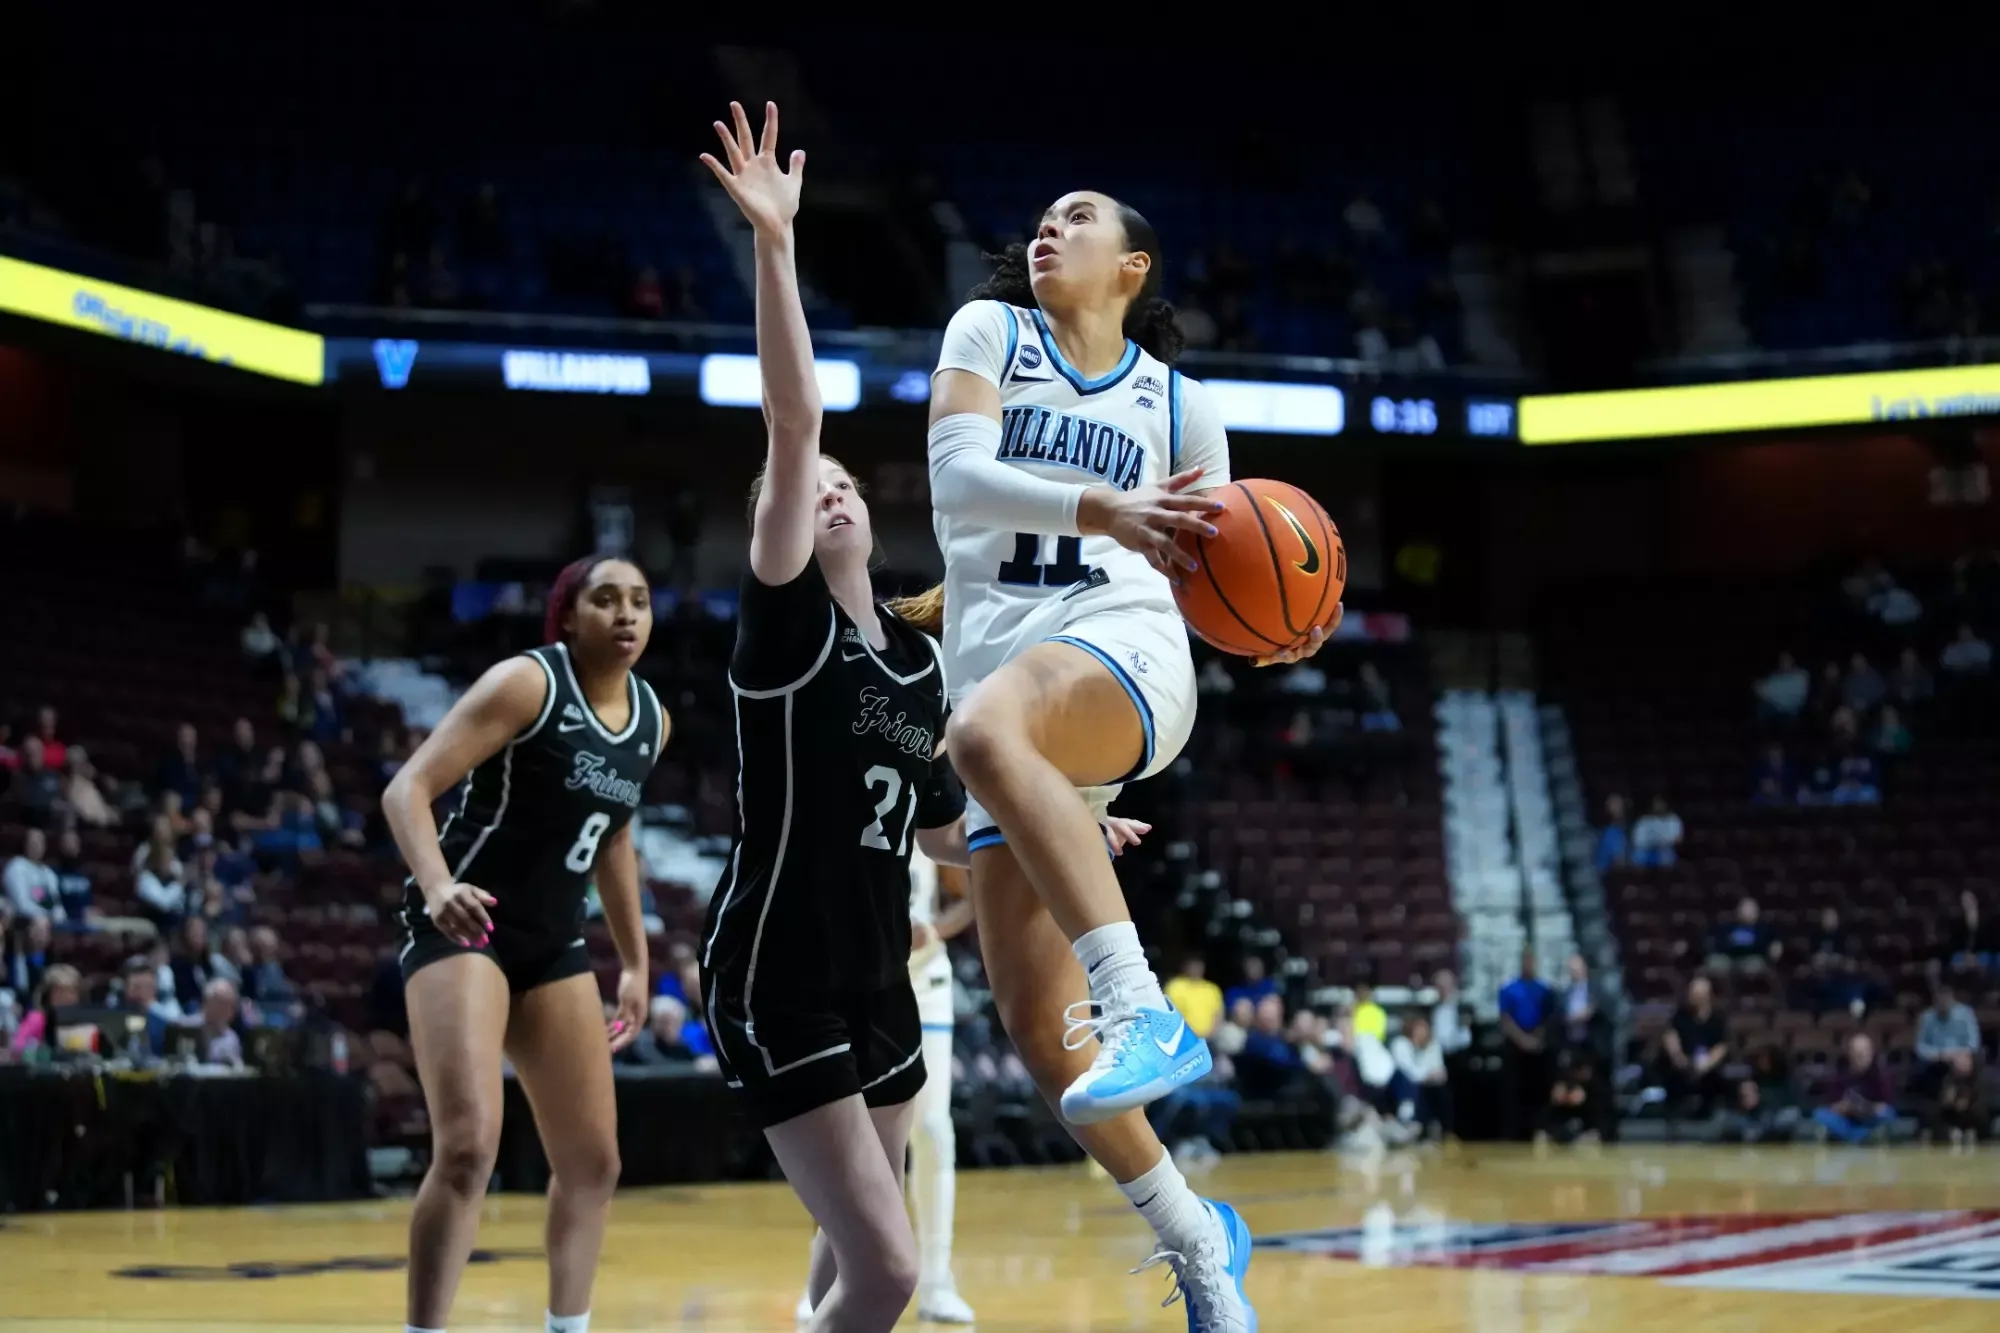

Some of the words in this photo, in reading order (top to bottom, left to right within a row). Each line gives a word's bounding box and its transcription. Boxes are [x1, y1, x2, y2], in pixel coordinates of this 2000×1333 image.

[840, 635, 864, 645] CHAN
[860, 764, 918, 856] 21
[565, 811, 611, 874] 8
